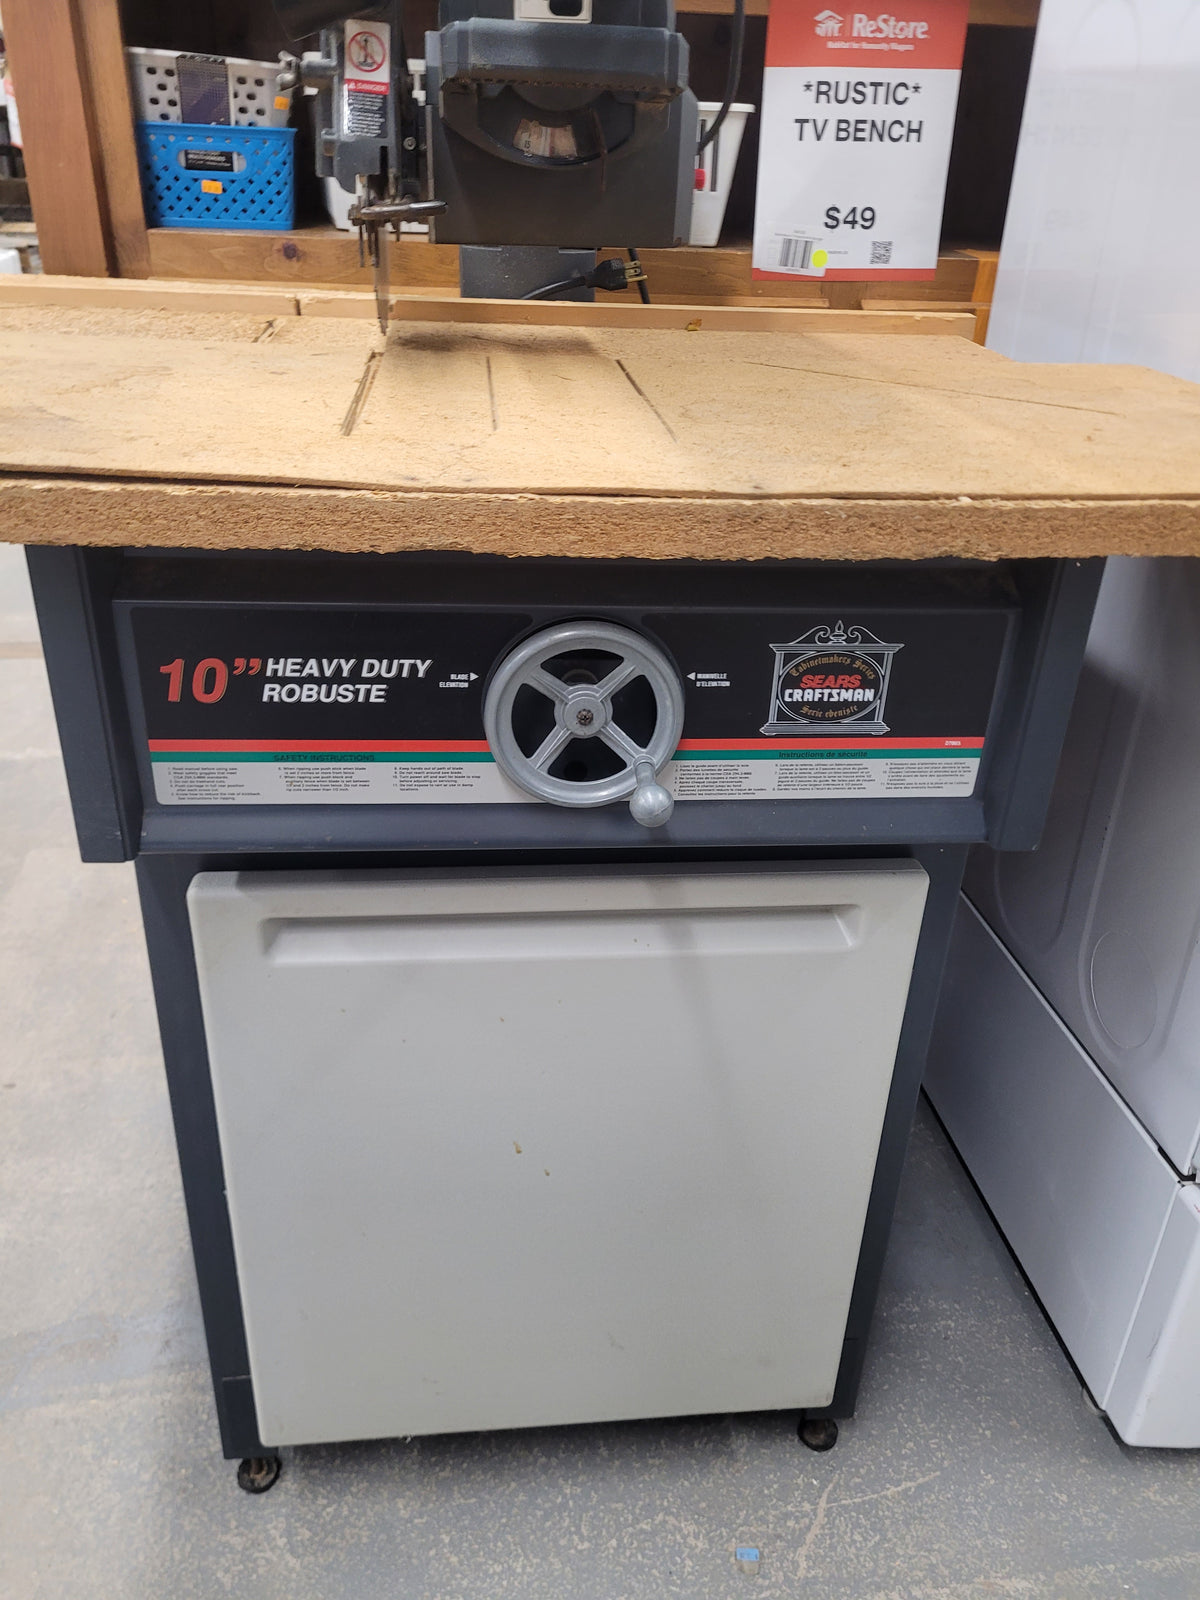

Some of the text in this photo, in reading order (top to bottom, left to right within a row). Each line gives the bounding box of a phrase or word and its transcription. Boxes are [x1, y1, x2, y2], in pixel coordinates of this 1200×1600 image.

[852, 13, 930, 39] ReStore
[794, 118, 923, 143] TV BENCH
[824, 204, 876, 232] $49
[265, 657, 357, 678] HEAVY
[361, 658, 433, 678] DUTY
[799, 674, 862, 689] SEARS
[262, 683, 388, 703] ROBUSTE
[784, 688, 875, 702] CRAFTSMAN
[779, 751, 825, 759] Instructions
